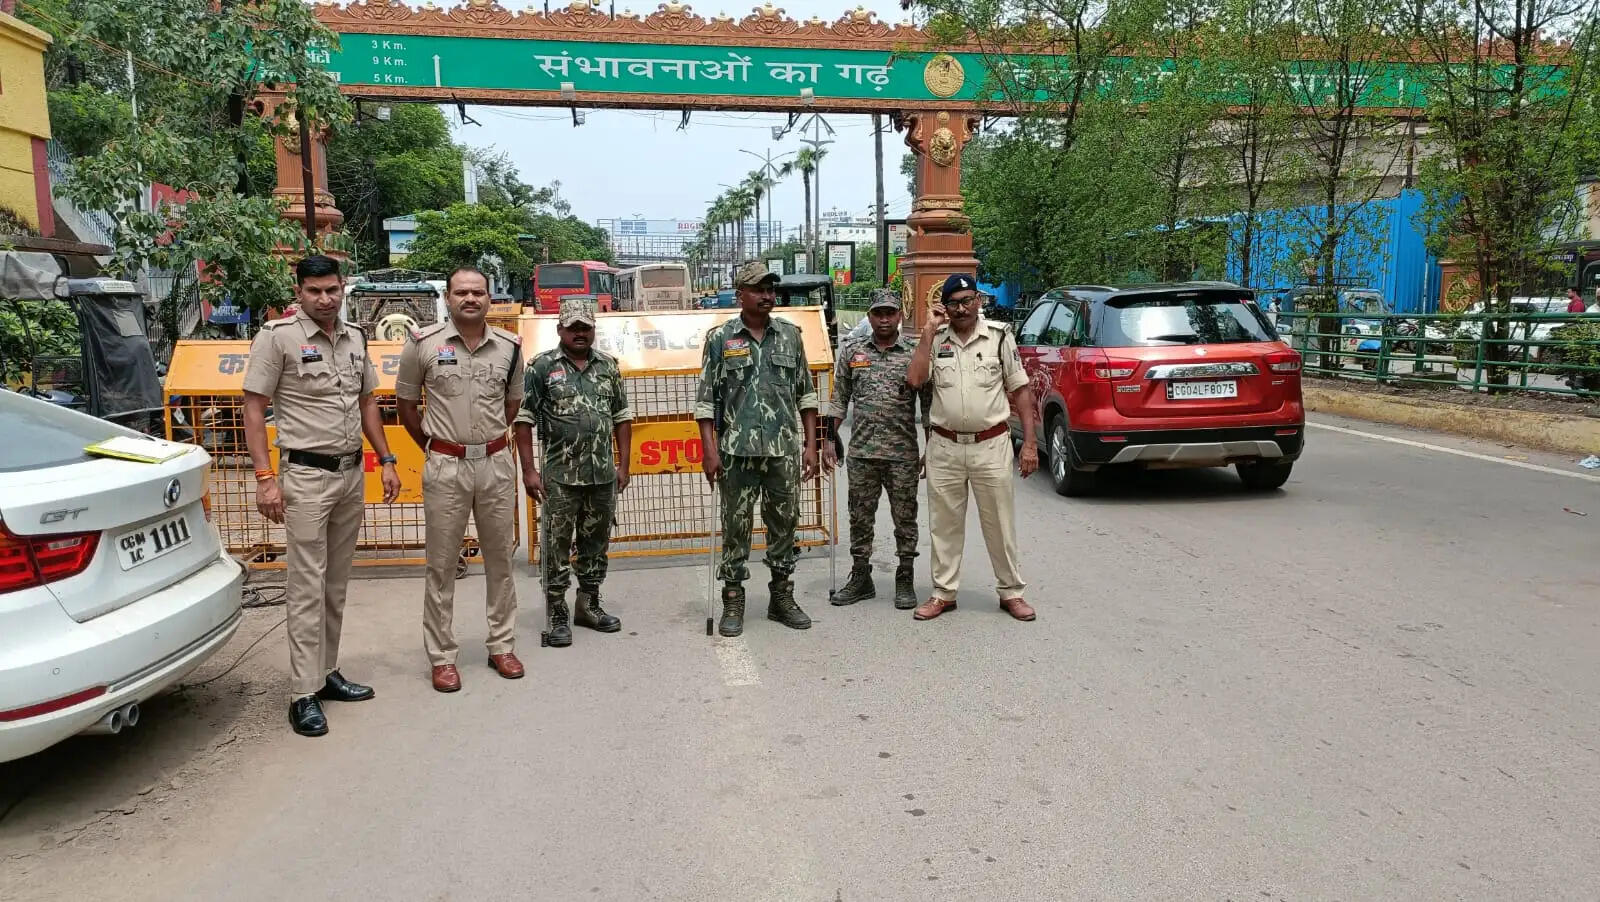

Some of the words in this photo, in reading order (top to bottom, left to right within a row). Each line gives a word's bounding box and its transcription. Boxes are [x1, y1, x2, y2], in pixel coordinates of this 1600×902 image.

[371, 39, 378, 49] 3
[372, 56, 379, 65] 9
[373, 73, 380, 83] 5
[534, 50, 753, 82] संभावनाओं
[765, 62, 823, 84] का
[834, 63, 892, 92] गढ़
[1174, 383, 1235, 396] CG04LF8075
[639, 438, 704, 466] STO
[39, 506, 89, 524] GT
[149, 516, 191, 554] 1111
